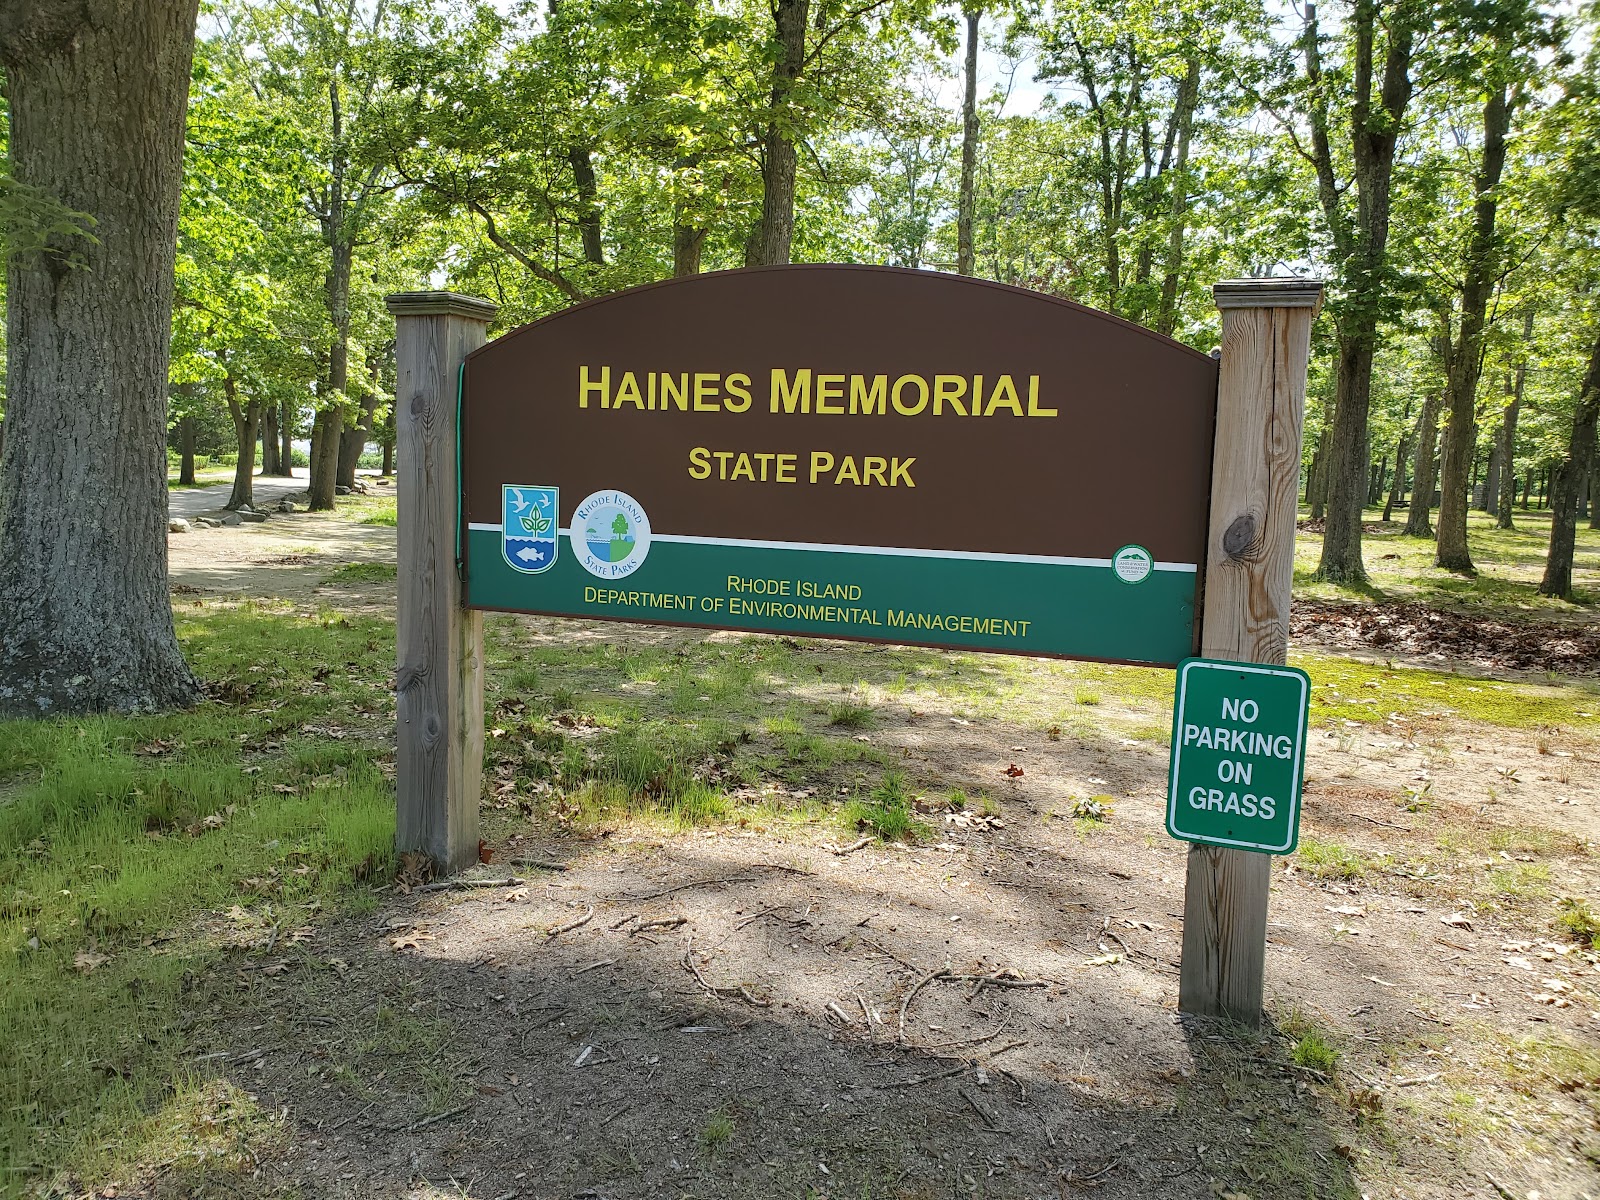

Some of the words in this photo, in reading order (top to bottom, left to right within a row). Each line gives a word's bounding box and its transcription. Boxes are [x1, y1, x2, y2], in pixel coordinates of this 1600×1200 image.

[579, 365, 753, 413] HAINES
[769, 368, 1058, 418] MEMORIAL
[688, 447, 797, 483] STATE
[810, 451, 916, 488] PARK
[577, 495, 610, 520] RHODE
[614, 494, 642, 524] ISLAND
[584, 555, 607, 576] STATE
[611, 558, 637, 576] PARKS
[727, 575, 791, 597] RHODE
[797, 580, 863, 601] ISLAND
[584, 586, 697, 611] DEPARTMENT
[701, 597, 724, 613] OF
[729, 598, 881, 627] ENVIRONMENTAL
[887, 609, 1032, 637] MANAGEMENT
[1221, 697, 1259, 723] NO
[1184, 724, 1292, 760] PARKING
[1217, 759, 1253, 786] ON
[1189, 786, 1276, 820] GRASS
